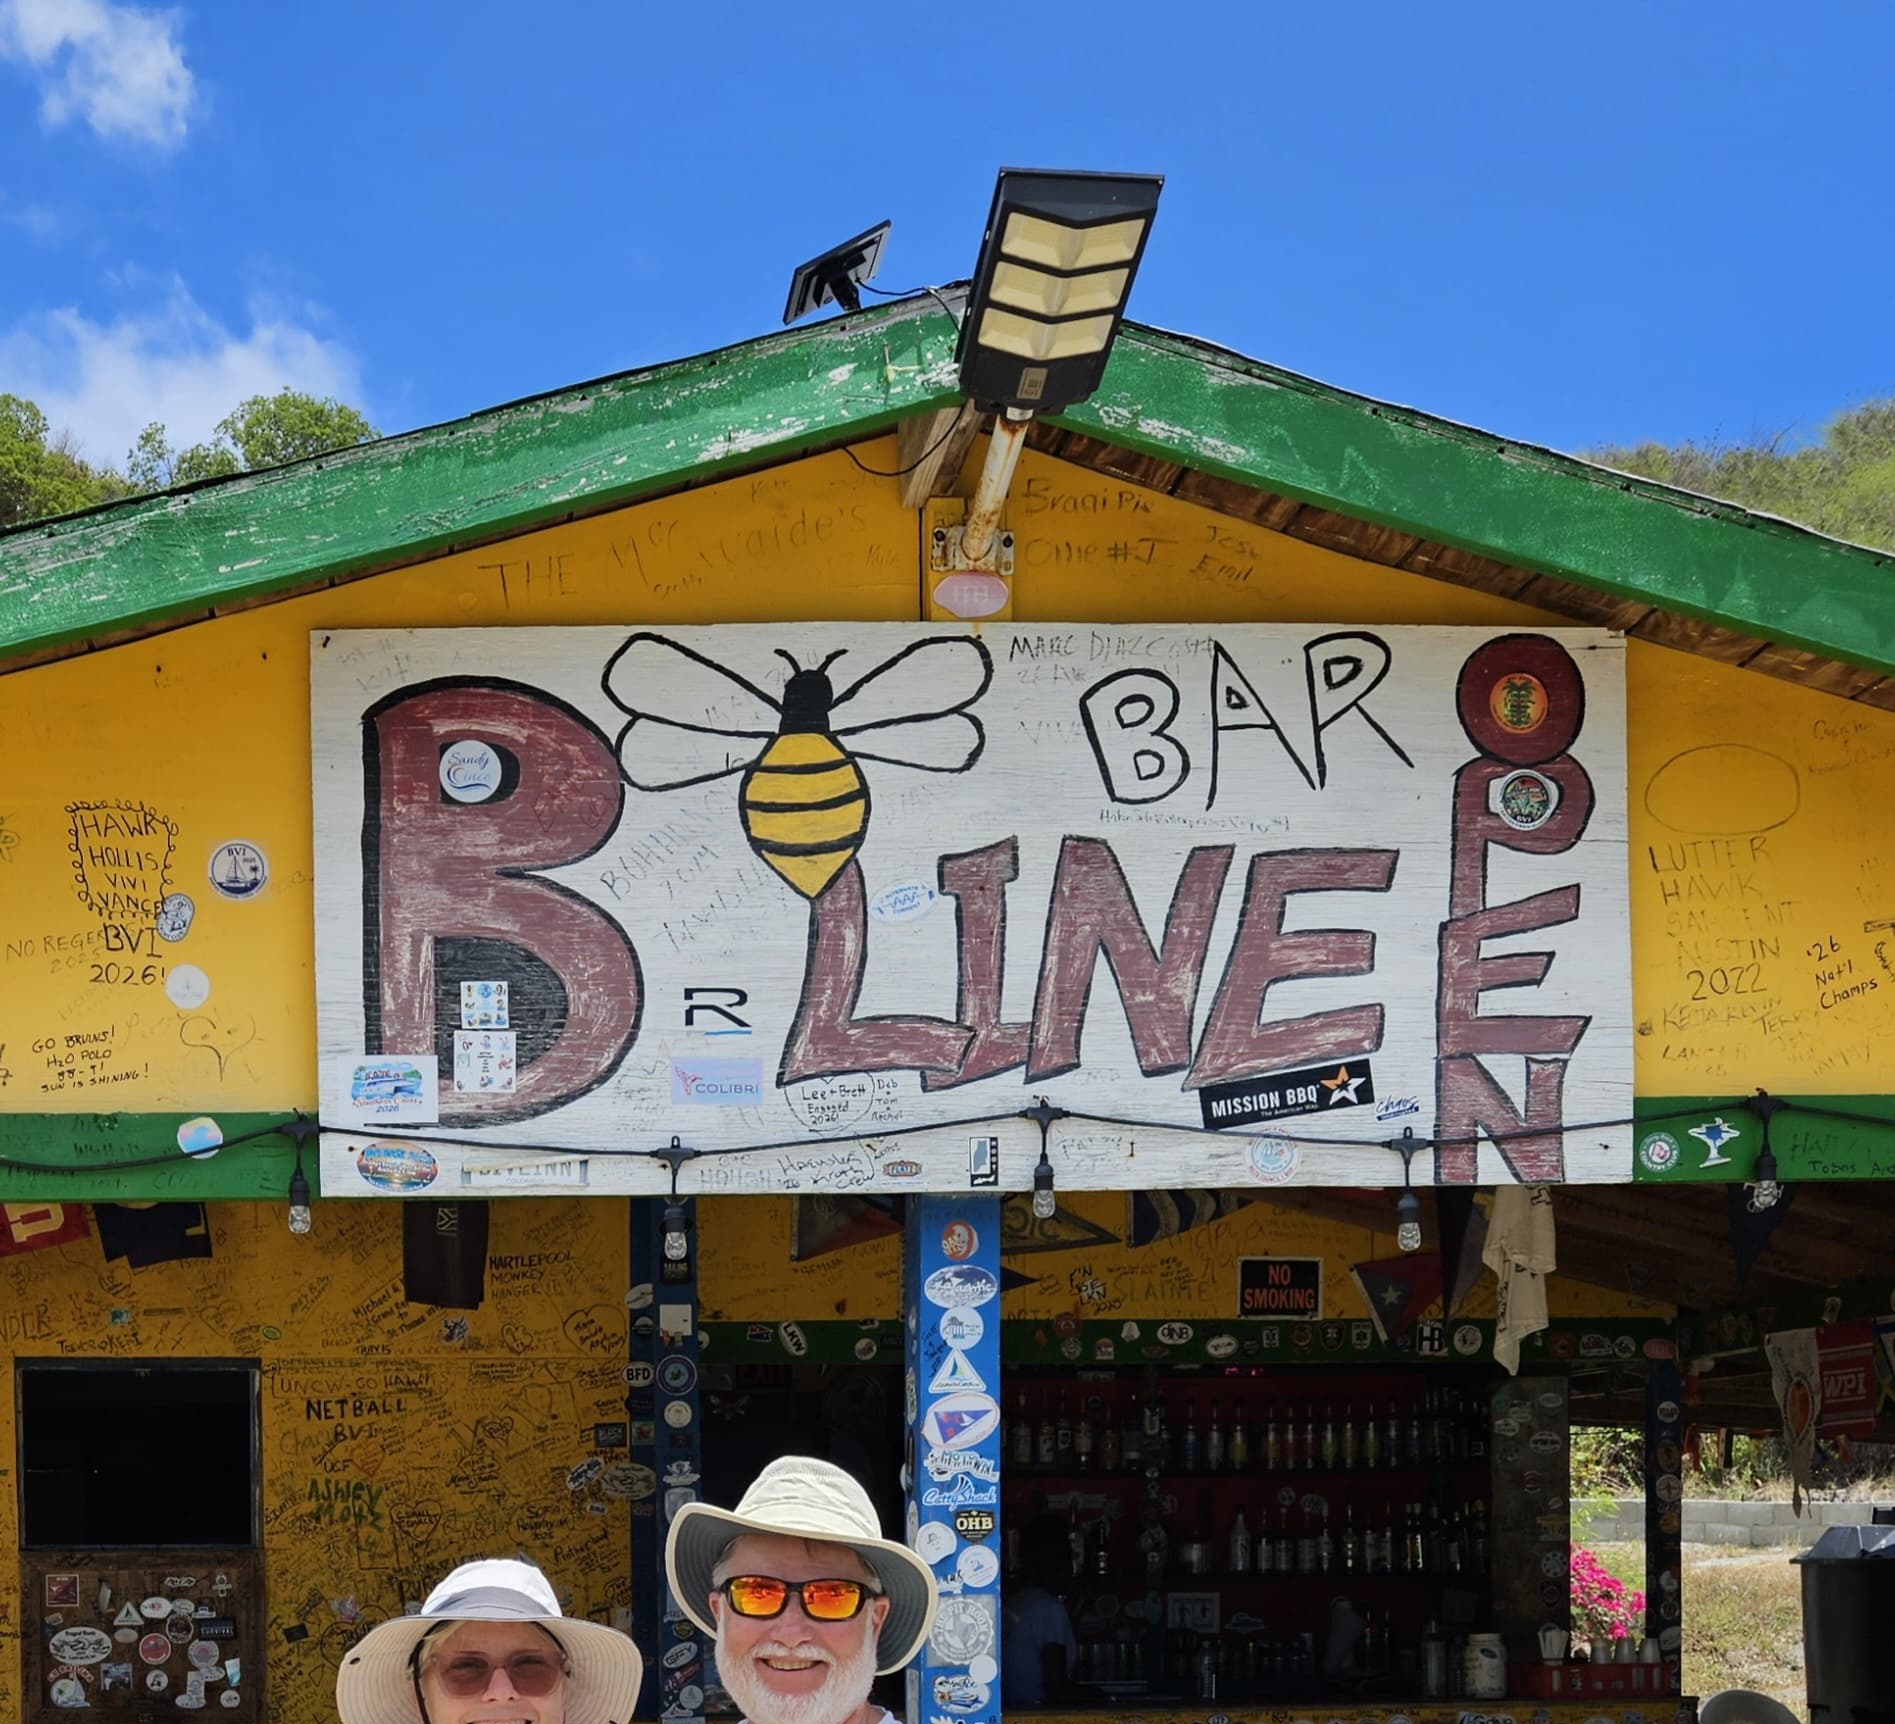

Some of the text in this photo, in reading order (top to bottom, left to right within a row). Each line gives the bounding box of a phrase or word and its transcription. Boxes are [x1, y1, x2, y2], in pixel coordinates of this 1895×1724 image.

[478, 552, 579, 608] THE
[1078, 630, 1415, 812] BAR
[80, 812, 159, 839] HAWK
[88, 845, 159, 873] HOLLIS
[227, 847, 247, 857] BVI
[1648, 836, 1773, 874] LUTTER
[105, 873, 147, 892] VIVI
[1661, 876, 1763, 906] HAWK
[97, 892, 163, 913] VANCE
[1434, 632, 1597, 1184] OPEN
[103, 924, 163, 958] BVI
[774, 832, 1401, 1092] LINE
[89, 962, 166, 986] 2026!
[1685, 962, 1769, 1002] 2022
[1820, 978, 1879, 1010] Champs
[684, 986, 753, 1029] R
[32, 1024, 116, 1054] GO BRUINS!
[81, 1048, 113, 1061] POLO
[41, 1081, 66, 1094] SUN
[72, 1077, 84, 1089] IS
[89, 1070, 140, 1088] SHINING
[801, 1086, 827, 1101] Lee
[839, 1082, 867, 1098] Brett
[877, 1078, 898, 1090] Deb
[375, 1103, 400, 1113] 2026
[807, 1101, 849, 1114] Engaged
[1211, 1085, 1318, 1119] MISSION BBQ
[1274, 1104, 1304, 1117] American
[488, 1250, 576, 1270] HARTLEPOOL
[490, 1269, 545, 1285] MONKEY
[1266, 1264, 1292, 1286] NO
[490, 1284, 542, 1300] HANGER
[1243, 1287, 1316, 1310] SMOKING
[355, 1377, 378, 1389] GO
[626, 1367, 651, 1381] BFD
[1822, 1371, 1868, 1396] WPI
[305, 1398, 409, 1422] NETBALL
[333, 1422, 374, 1443] BVI
[324, 1459, 350, 1474] UCF
[956, 1516, 994, 1531] OHB
[947, 1602, 965, 1615] PIT
